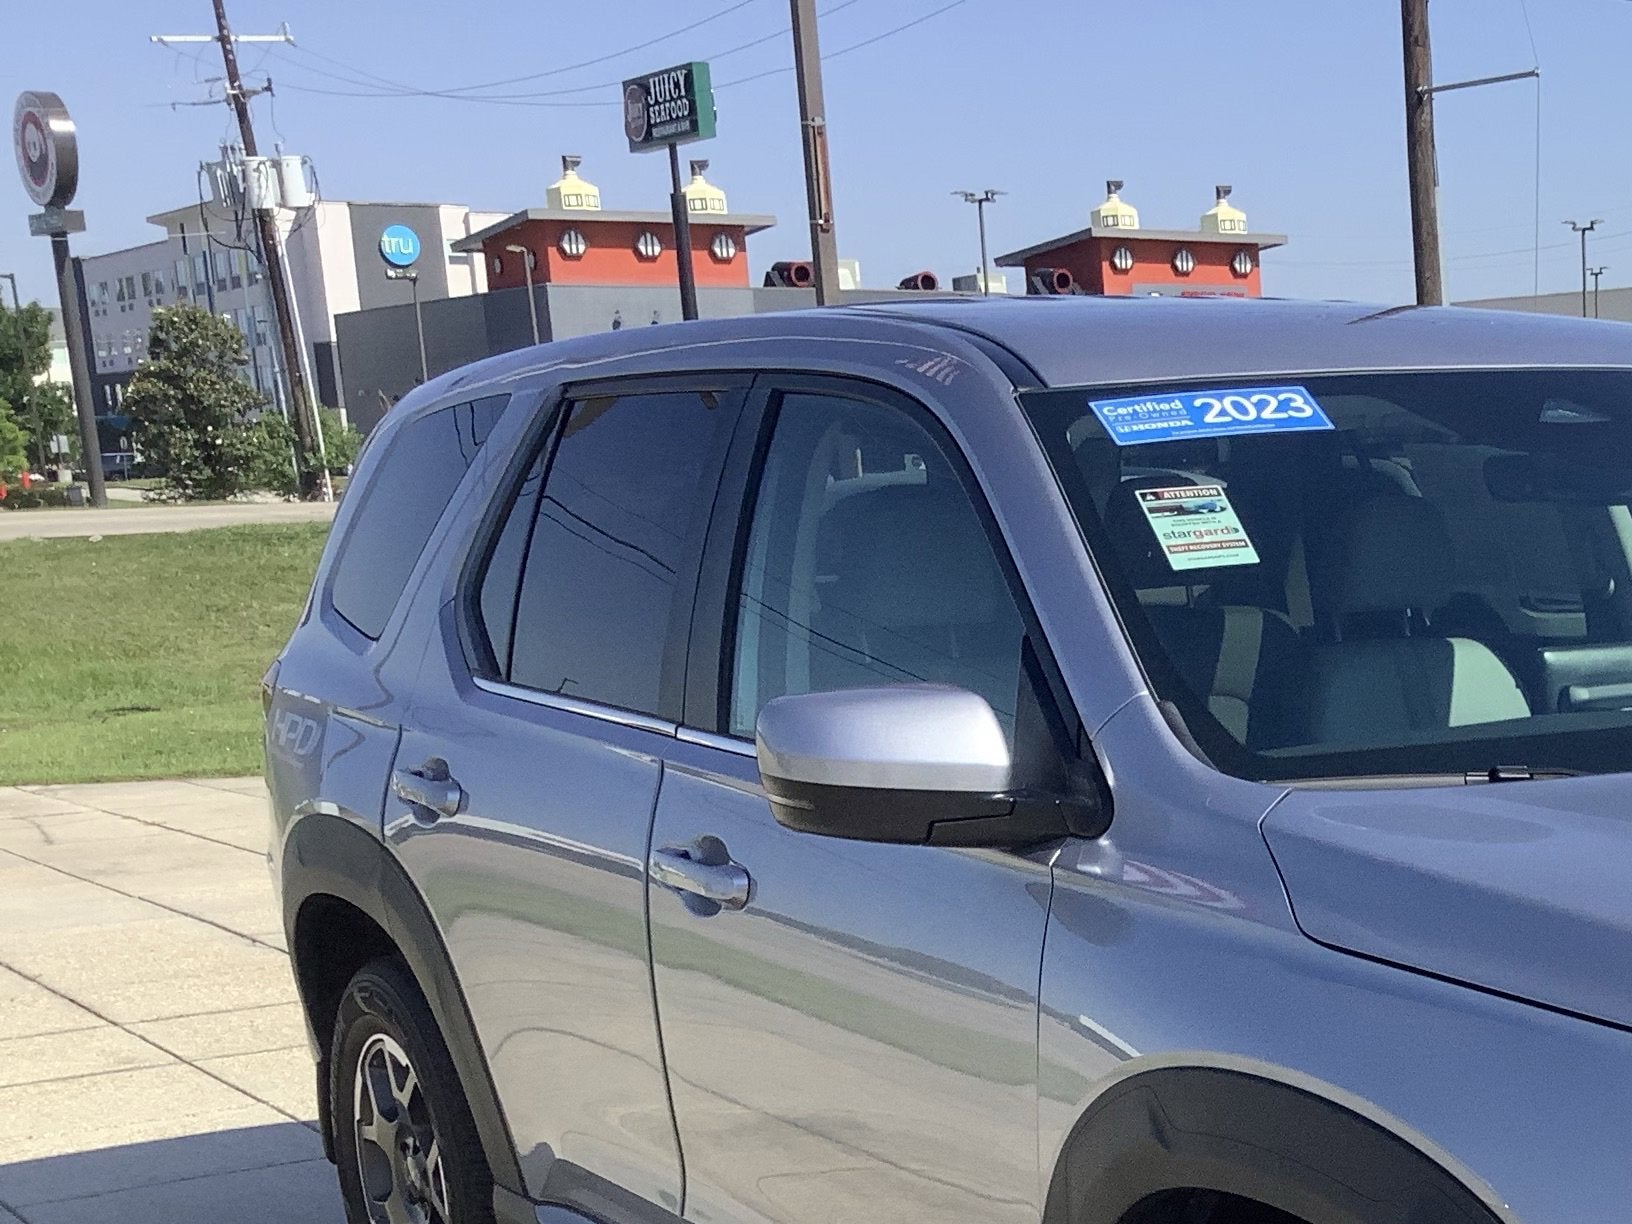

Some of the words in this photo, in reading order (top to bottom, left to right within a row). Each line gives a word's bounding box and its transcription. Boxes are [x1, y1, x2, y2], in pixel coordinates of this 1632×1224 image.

[648, 69, 688, 105] JUICY
[649, 98, 689, 124] SEAFOOD
[382, 232, 413, 255] tru
[1103, 400, 1183, 416] Certified
[1193, 393, 1314, 423] 2023
[1131, 420, 1194, 432] HONDA
[1163, 488, 1218, 499] ATTENTION
